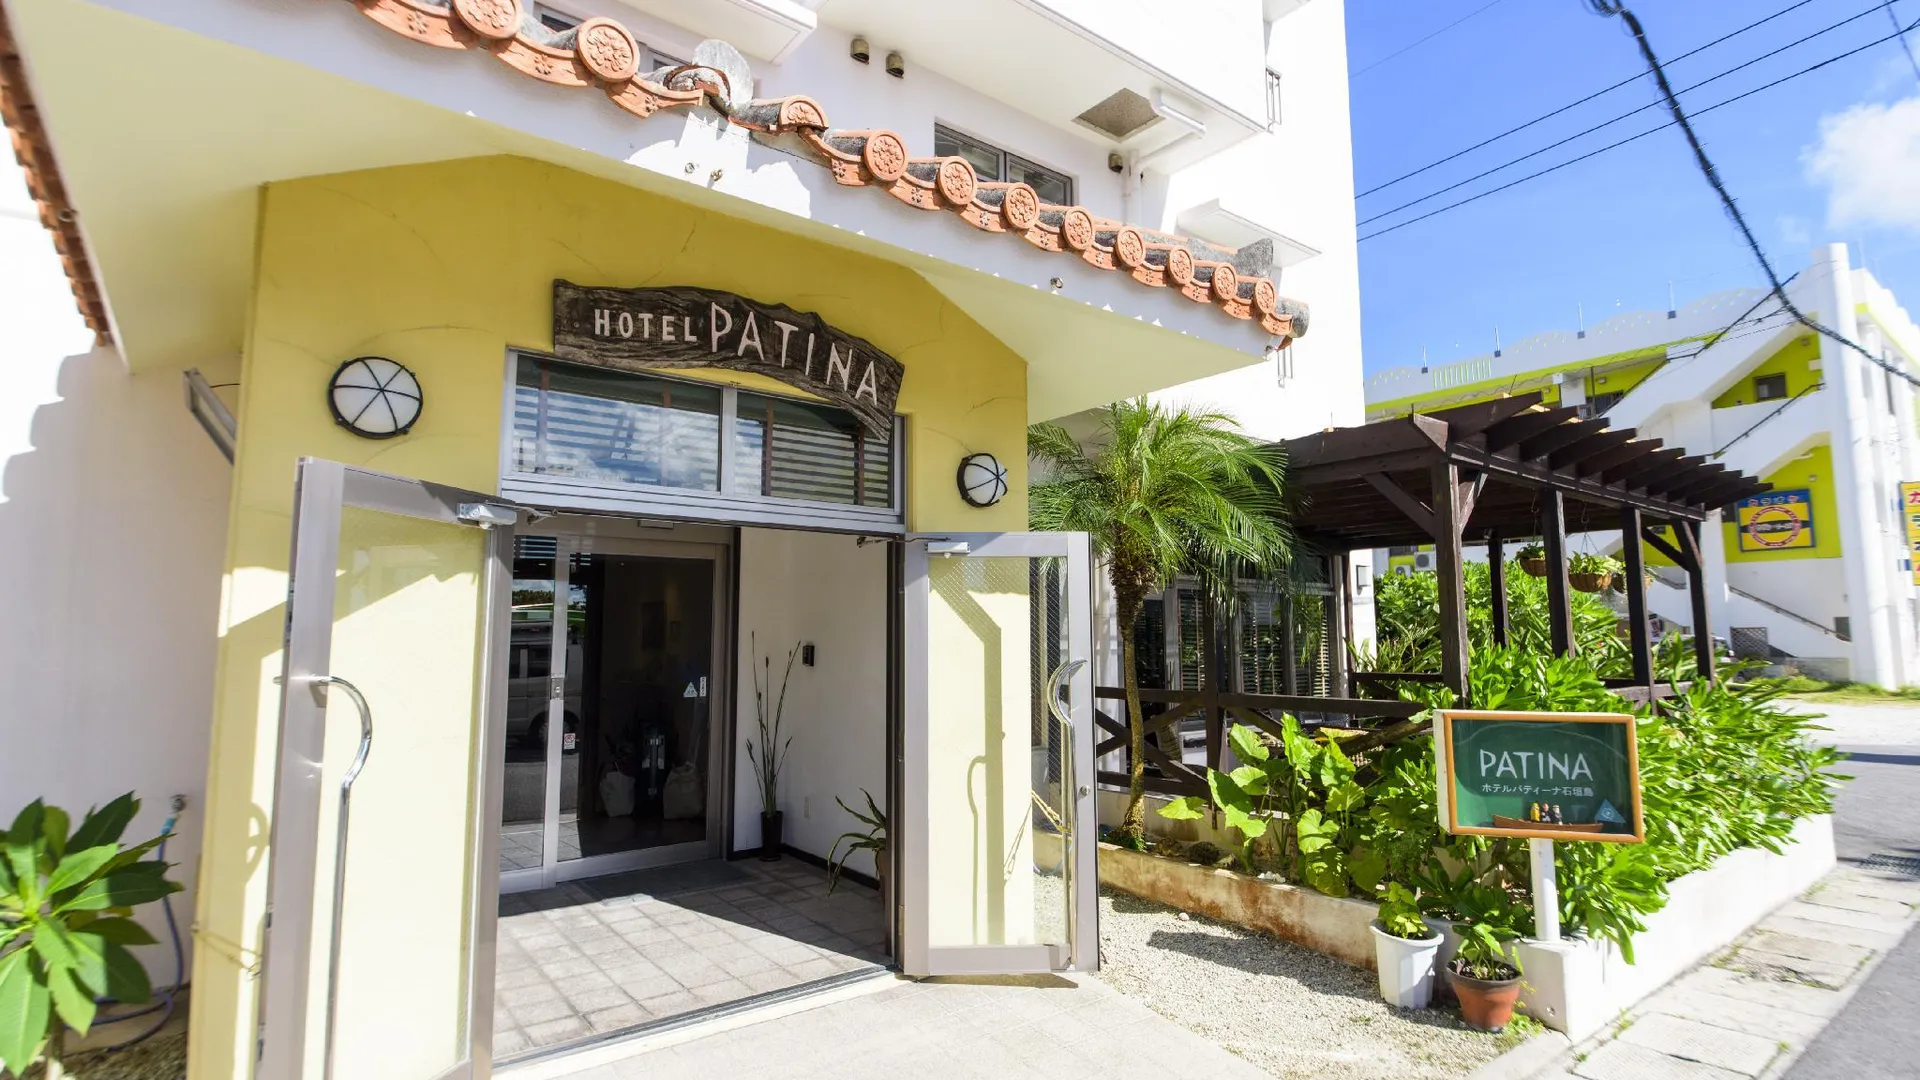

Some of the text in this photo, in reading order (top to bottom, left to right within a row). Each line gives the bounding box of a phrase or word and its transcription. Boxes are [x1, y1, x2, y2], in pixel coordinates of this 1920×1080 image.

[594, 302, 878, 406] HOTEL PATINA
[1479, 748, 1594, 782] PATINA
